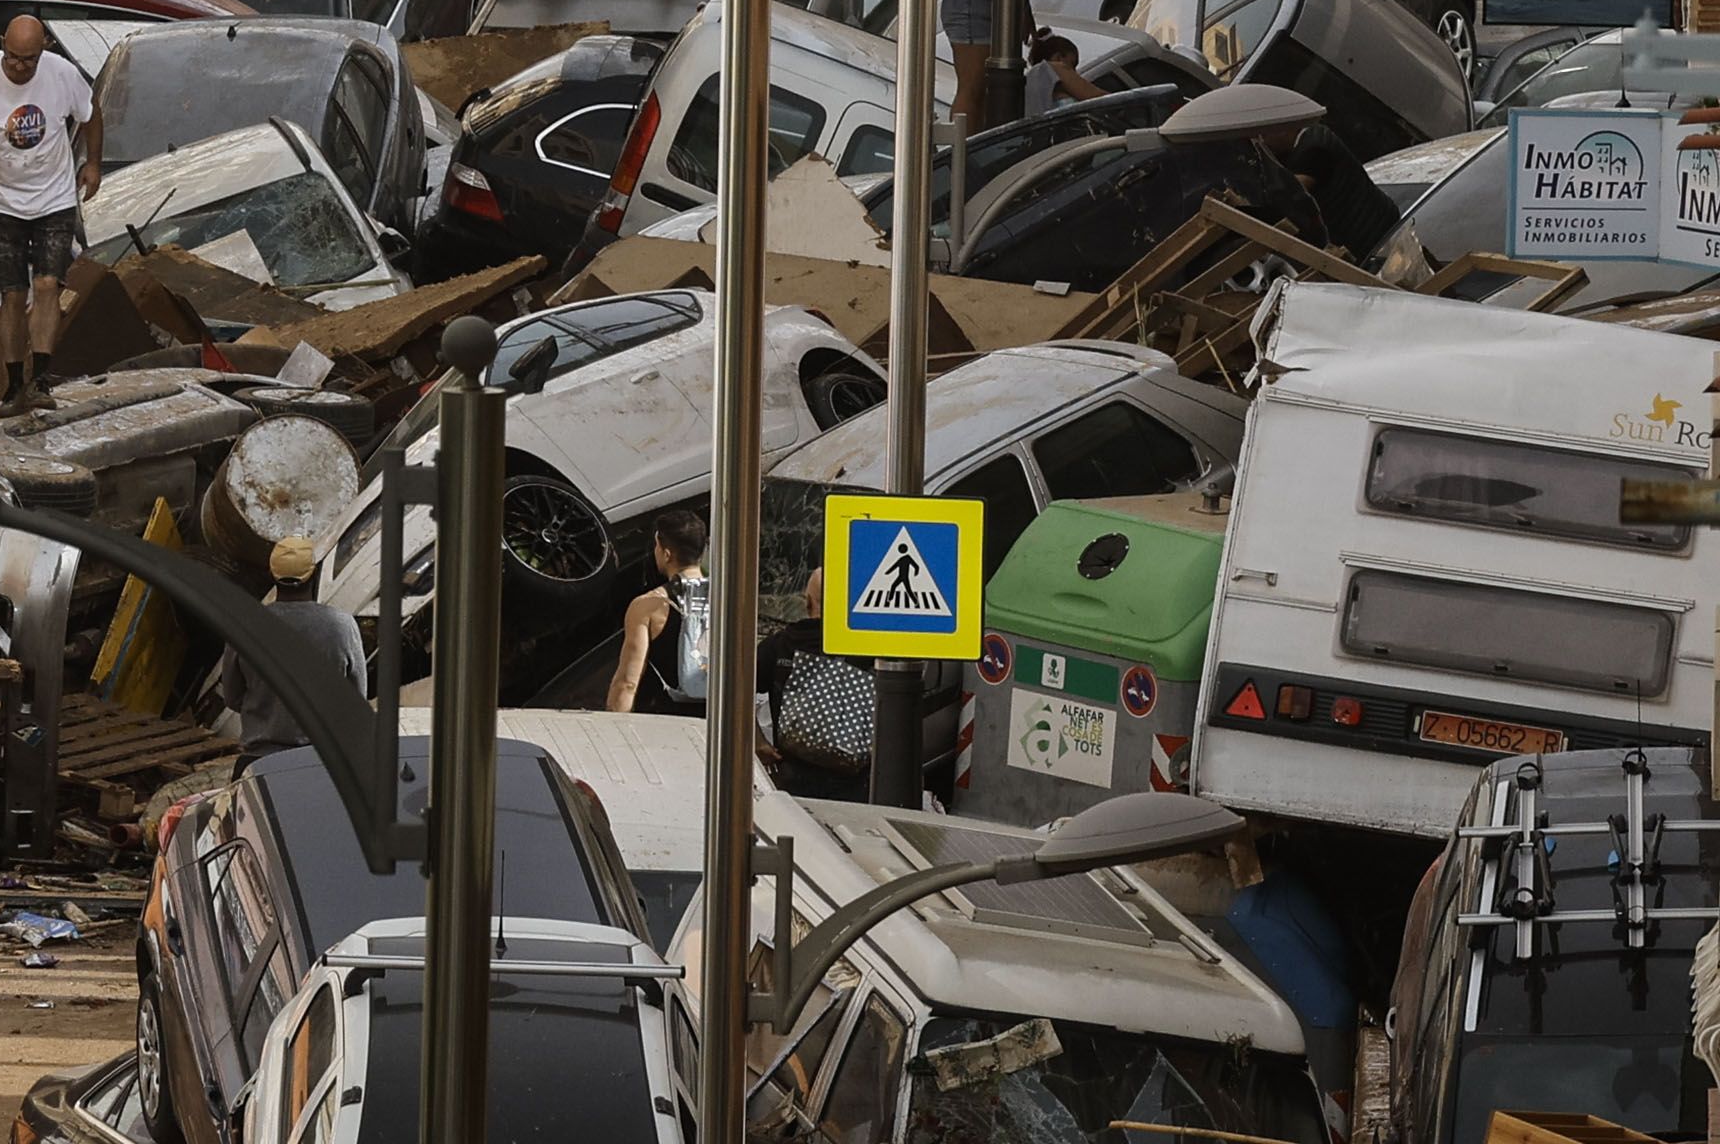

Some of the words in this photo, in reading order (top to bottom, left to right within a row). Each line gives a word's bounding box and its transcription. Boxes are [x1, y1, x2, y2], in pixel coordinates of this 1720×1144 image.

[12, 112, 41, 129] XXVI
[1524, 143, 1594, 170] INMO
[1535, 173, 1648, 200] HÁBITAT
[1525, 216, 1605, 229] SERVICIOS
[1524, 232, 1647, 244] INMOBILIARIOS
[1609, 413, 1665, 444] Sun
[1061, 704, 1104, 723] ALFAFAR
[1070, 716, 1089, 730] NET
[1073, 739, 1102, 756] TOTS
